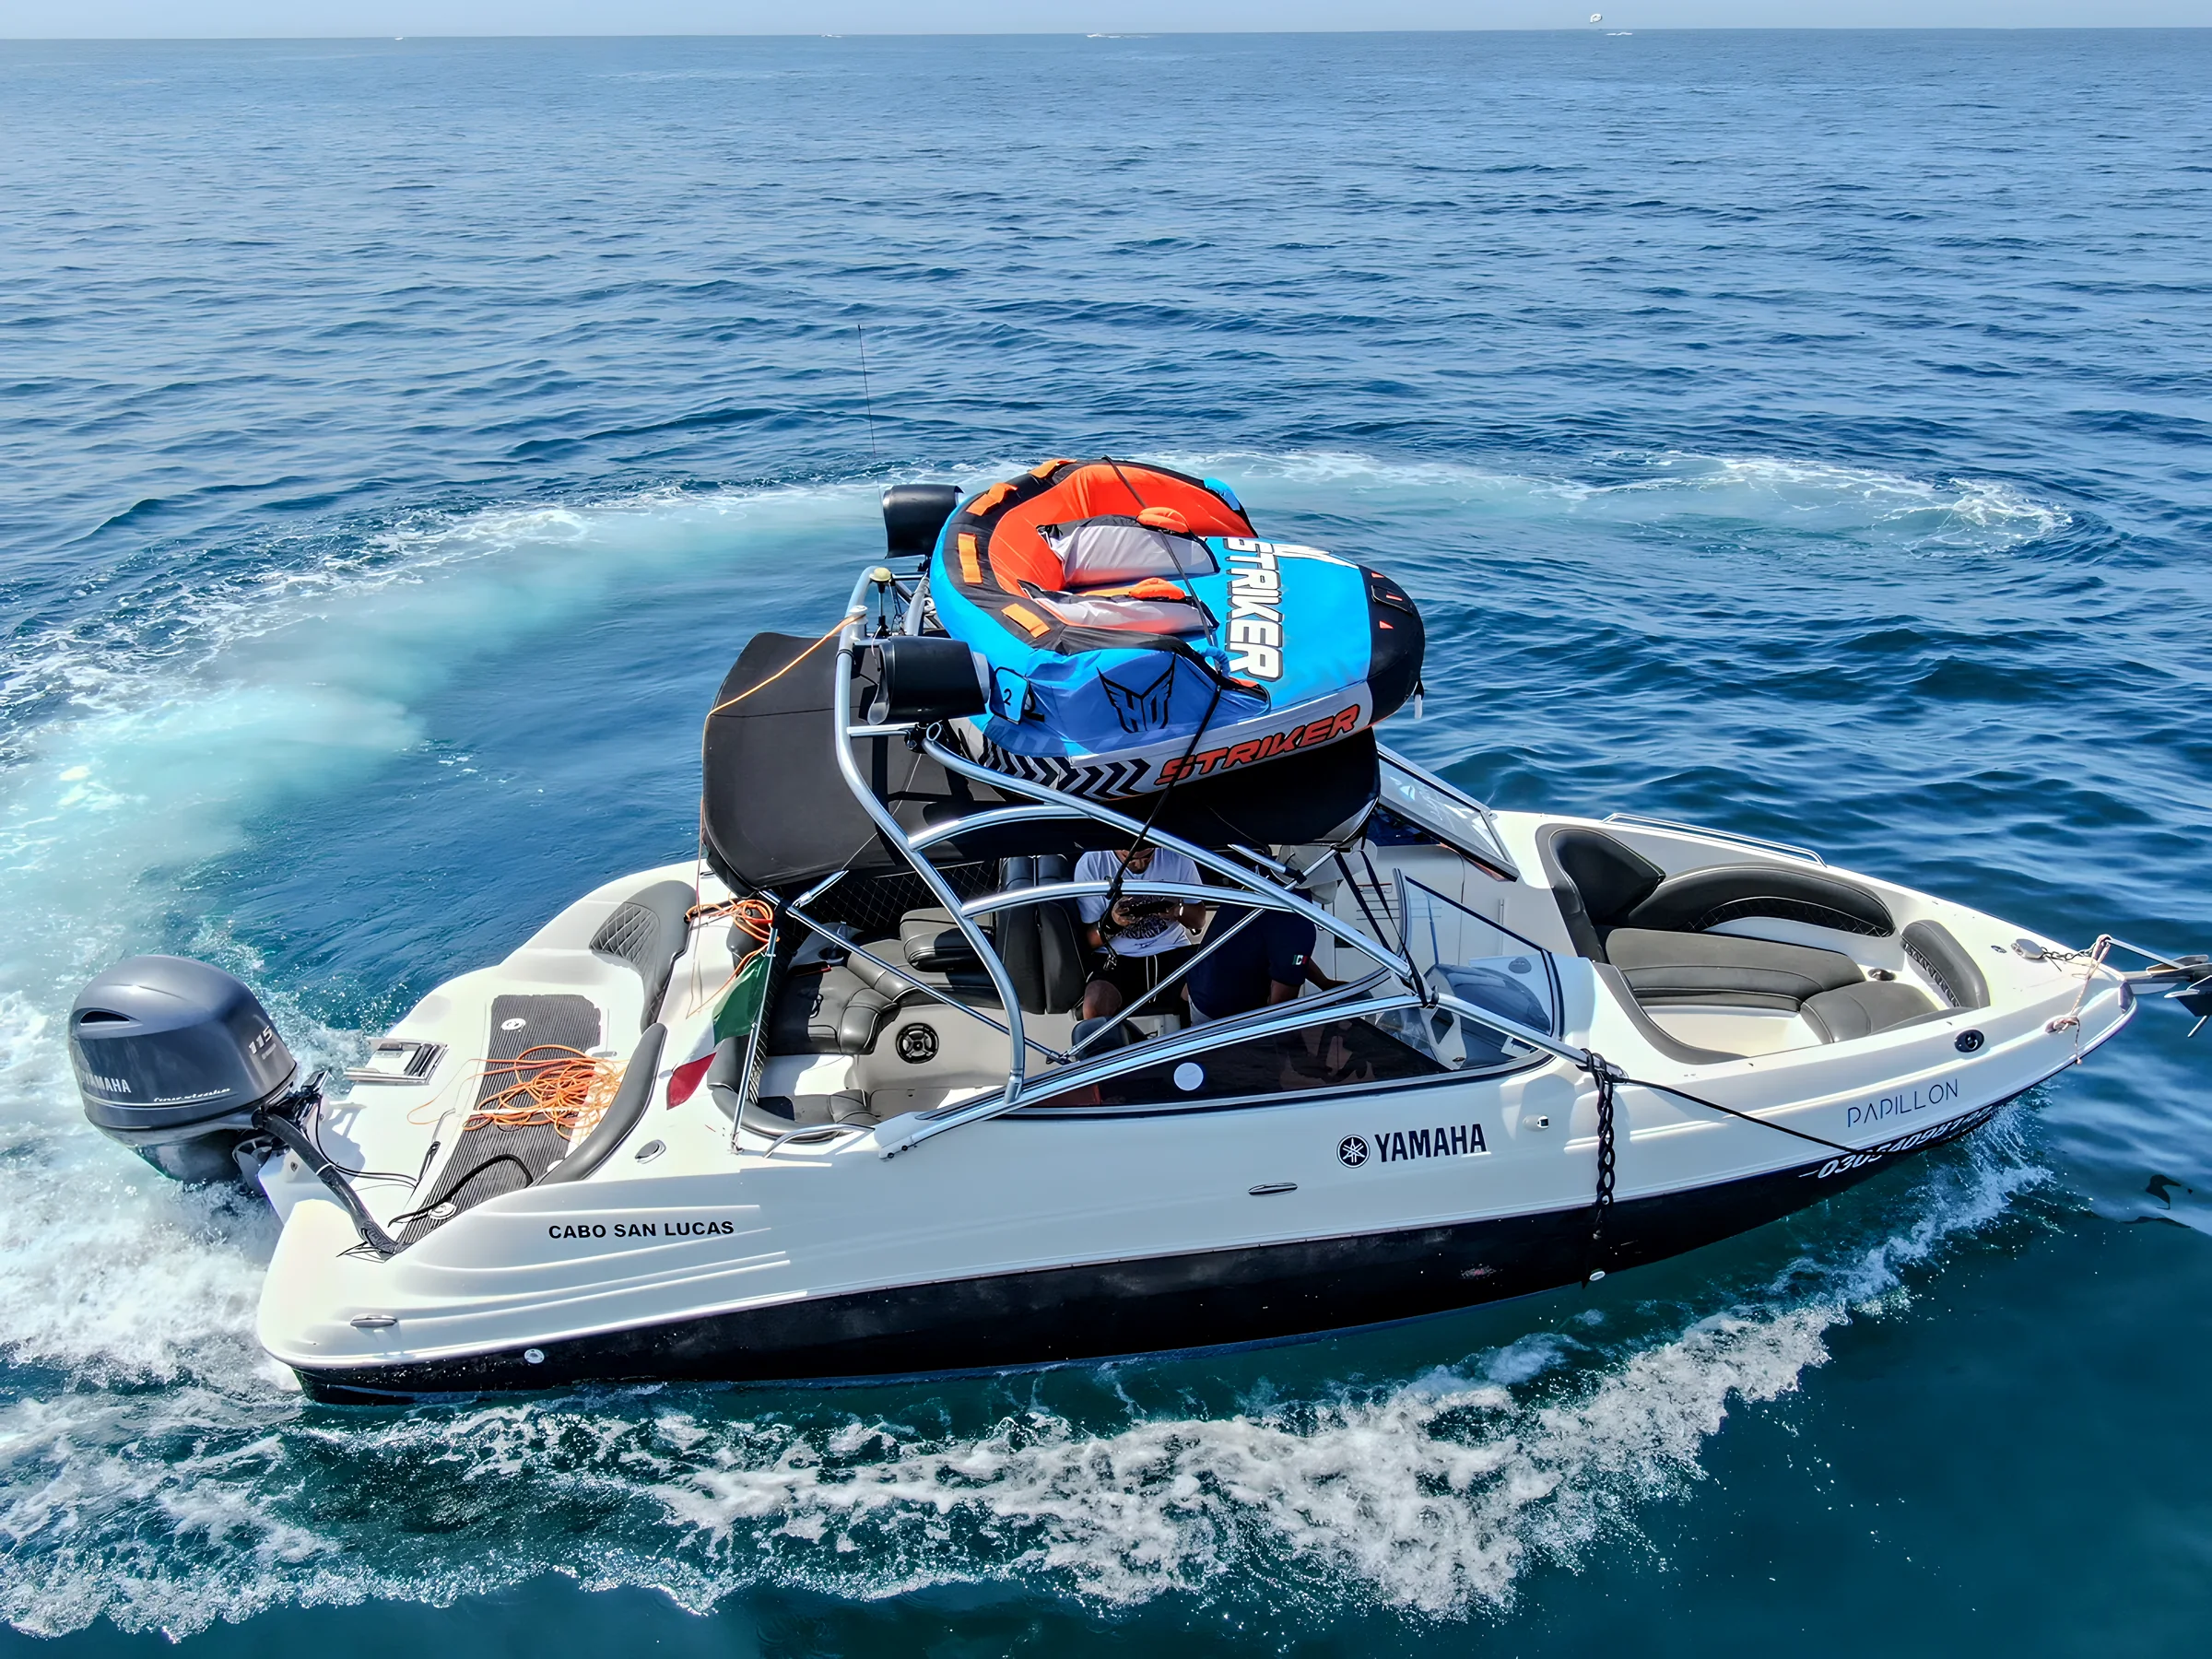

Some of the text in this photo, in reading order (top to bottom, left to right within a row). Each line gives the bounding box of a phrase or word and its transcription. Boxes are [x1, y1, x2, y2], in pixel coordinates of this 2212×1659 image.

[1224, 537, 1283, 682] STRIKER
[1003, 688, 1012, 707] 2
[1154, 703, 1360, 785] STRIKER
[248, 1025, 273, 1055] 115
[1847, 1078, 1959, 1128] PAPILLON
[1374, 1124, 1488, 1163] YAMAHA
[548, 1221, 735, 1239] CABO SAN LUCAS
